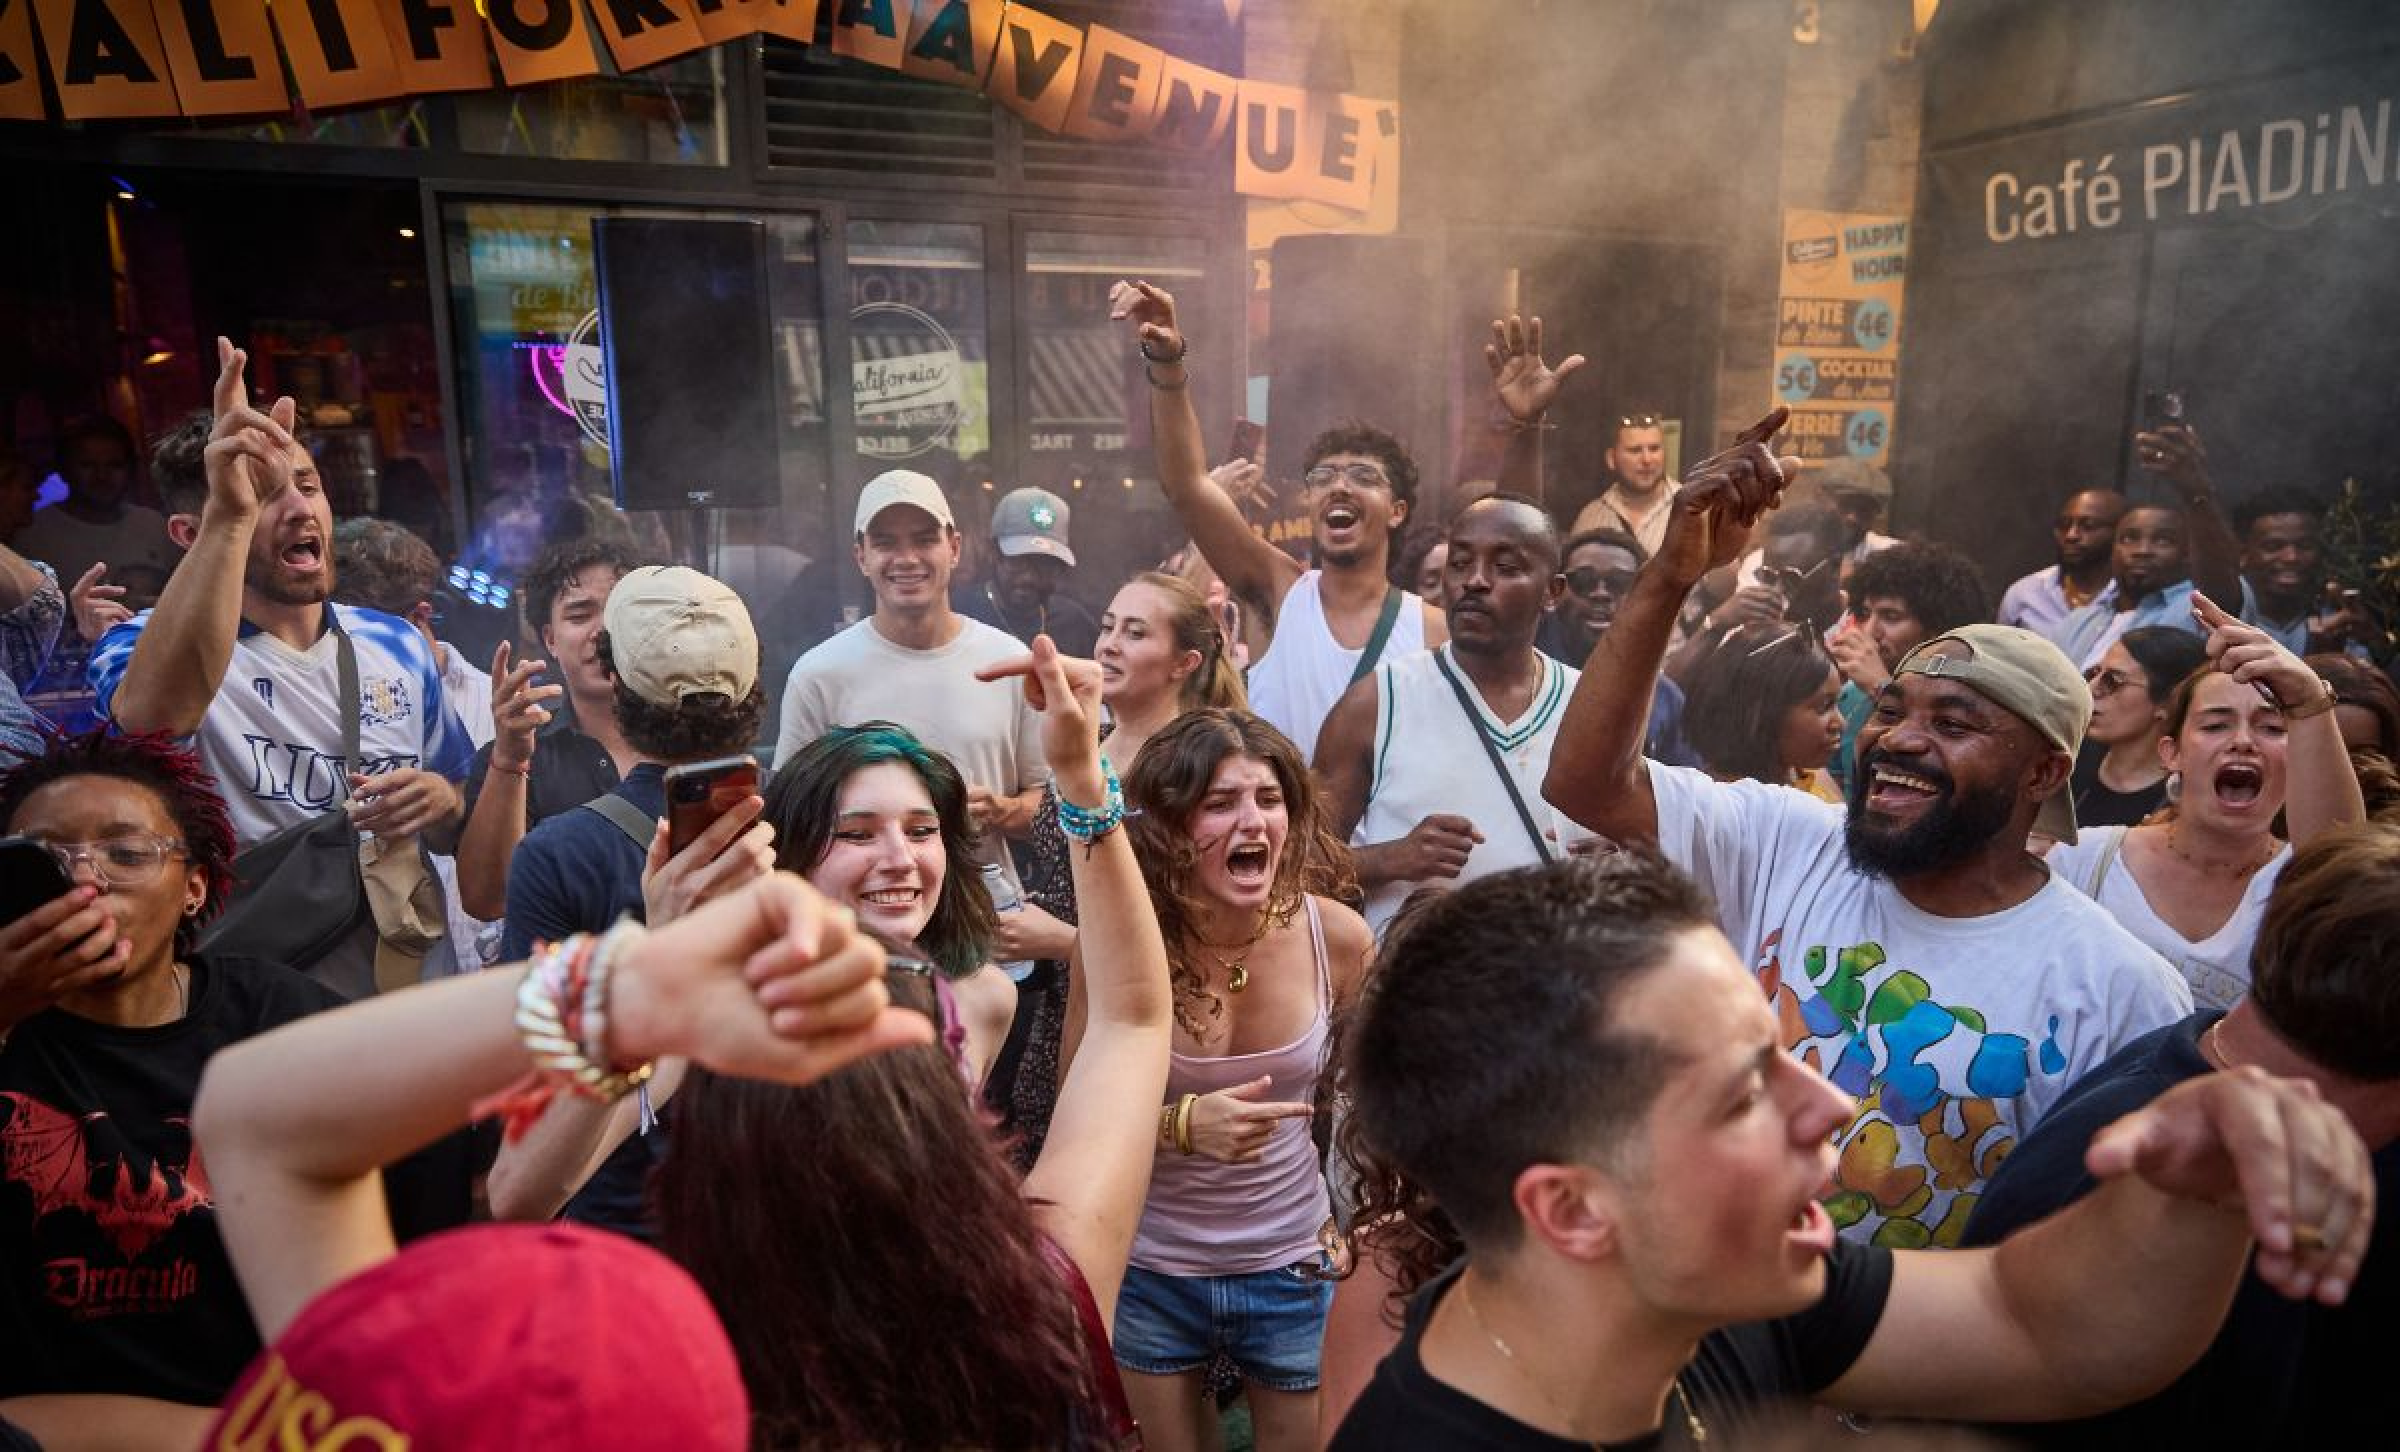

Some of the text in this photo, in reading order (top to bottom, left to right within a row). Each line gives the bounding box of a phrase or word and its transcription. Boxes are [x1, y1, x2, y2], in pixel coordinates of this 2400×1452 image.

[1793, 0, 1820, 43] 3
[909, 0, 1360, 183] AVENUE
[1984, 99, 2400, 242] Café PIADiN
[1845, 223, 1905, 251] HAPPY
[1853, 255, 1906, 279] HOUR
[1783, 301, 1845, 325] PINTE
[1859, 311, 1890, 338] 4€
[853, 361, 943, 397] alifornia
[1779, 364, 1814, 392] 5€
[1818, 360, 1896, 379] COCKTAIL
[1779, 412, 1843, 436] ERRE
[1851, 420, 1883, 448] 4€
[43, 1257, 198, 1306] Dracula
